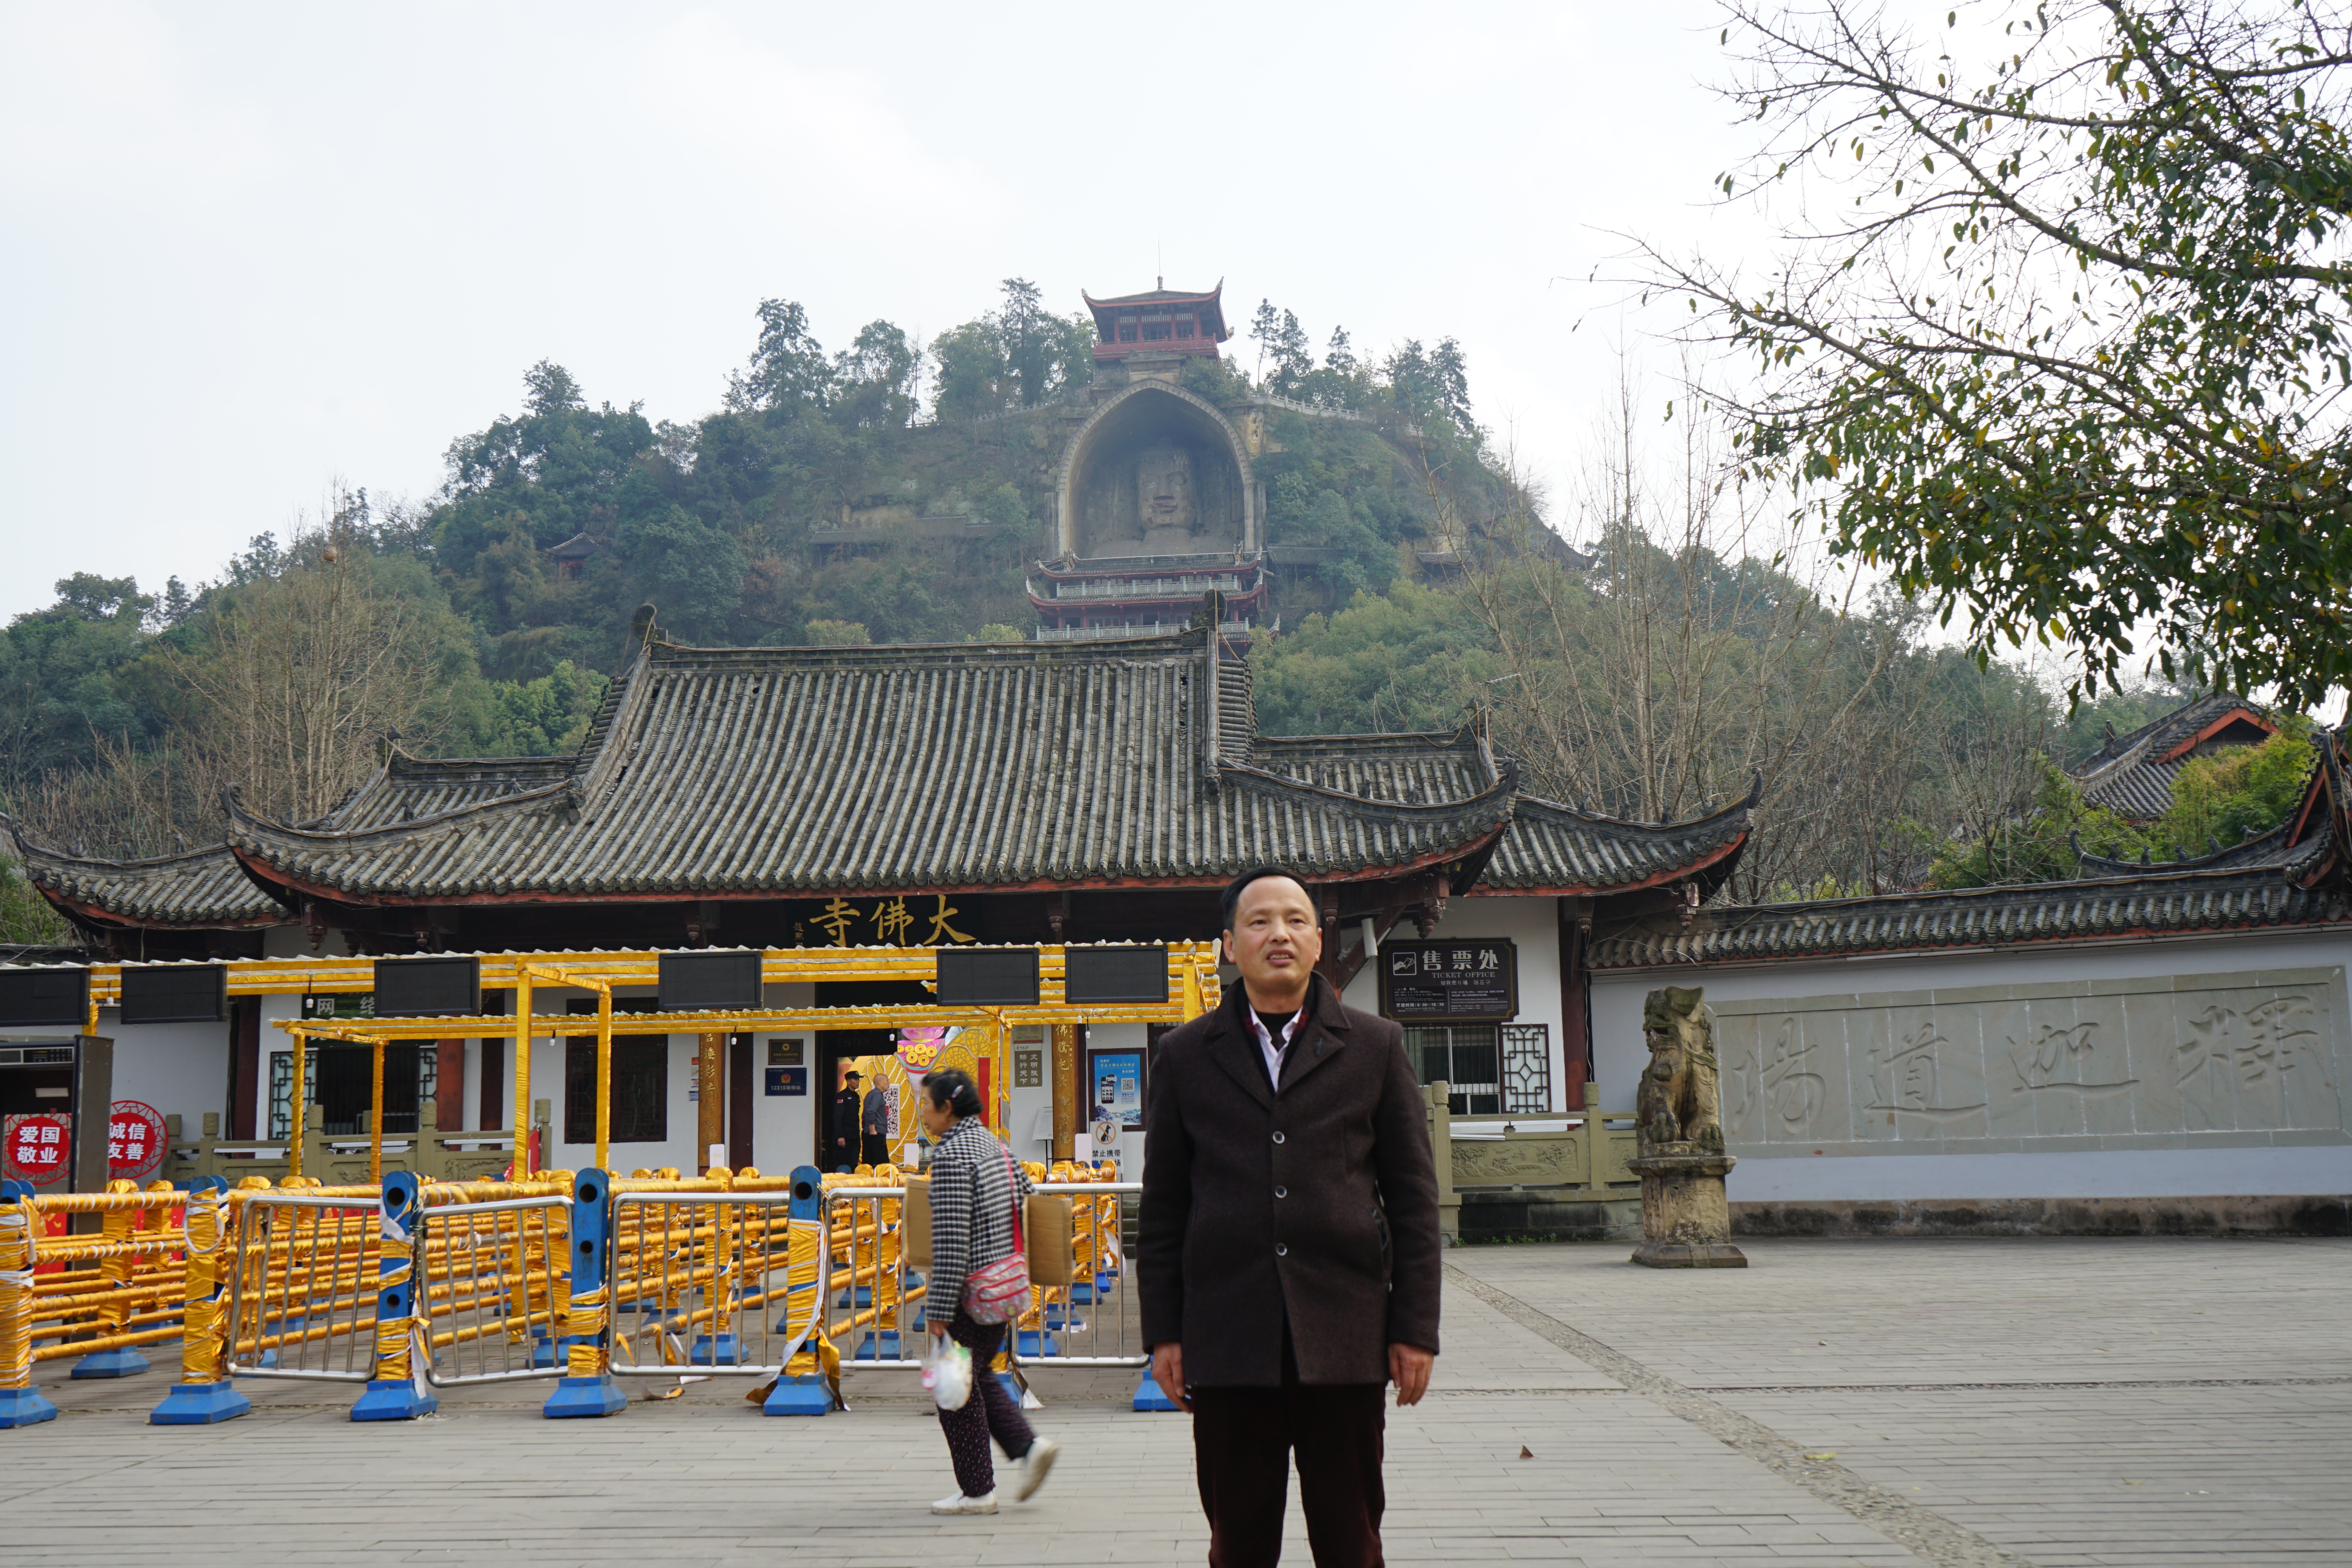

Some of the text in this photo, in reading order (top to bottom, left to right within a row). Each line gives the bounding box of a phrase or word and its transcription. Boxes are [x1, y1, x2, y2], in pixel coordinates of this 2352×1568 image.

[809, 894, 976, 947] 大佛寺
[1422, 949, 1499, 970] 售票处
[838, 1037, 871, 1047] ENTER
[1019, 1054, 1027, 1085] 畅行天下
[19, 1126, 60, 1143] 爱国
[109, 1122, 147, 1140] 诚信
[17, 1146, 58, 1163] 敬业
[108, 1142, 144, 1160] 友善
